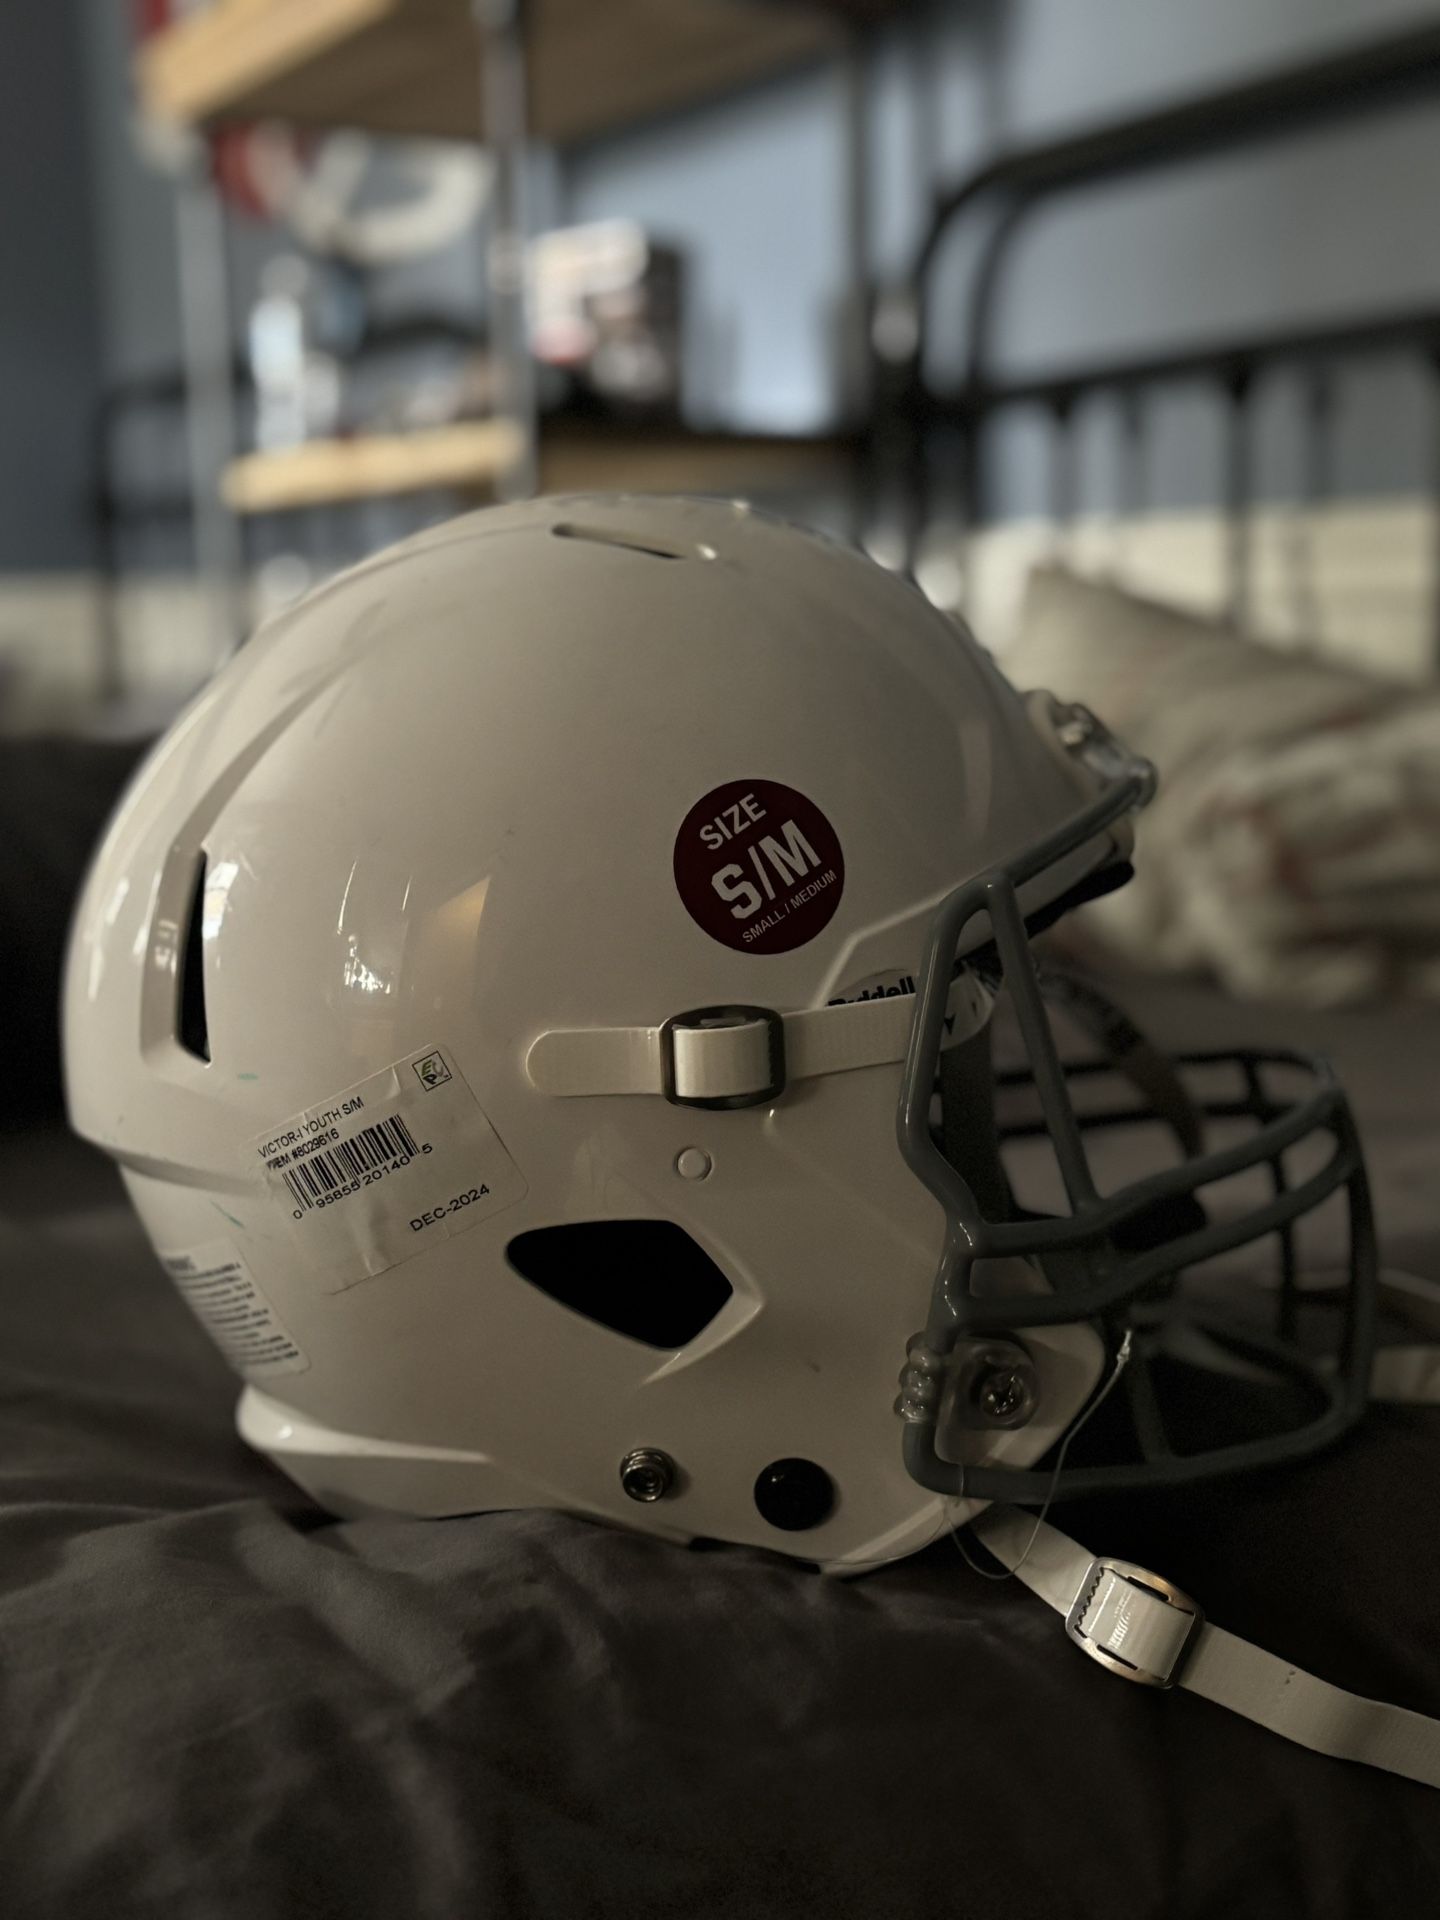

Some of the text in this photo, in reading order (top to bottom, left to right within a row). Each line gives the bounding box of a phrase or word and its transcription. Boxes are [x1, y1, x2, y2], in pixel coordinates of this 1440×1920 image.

[699, 792, 767, 850] SIZE
[710, 819, 822, 919] S/M
[742, 909, 786, 943] SMALL
[791, 868, 838, 909] MEDIUM
[257, 1096, 364, 1158] VICTOR-I YOUTH S/M
[291, 1128, 340, 1160] #8029616
[315, 1181, 361, 1209] 95855
[362, 1155, 411, 1186] 20140
[421, 1143, 433, 1155] 5
[409, 1184, 490, 1232] DEC-2024
